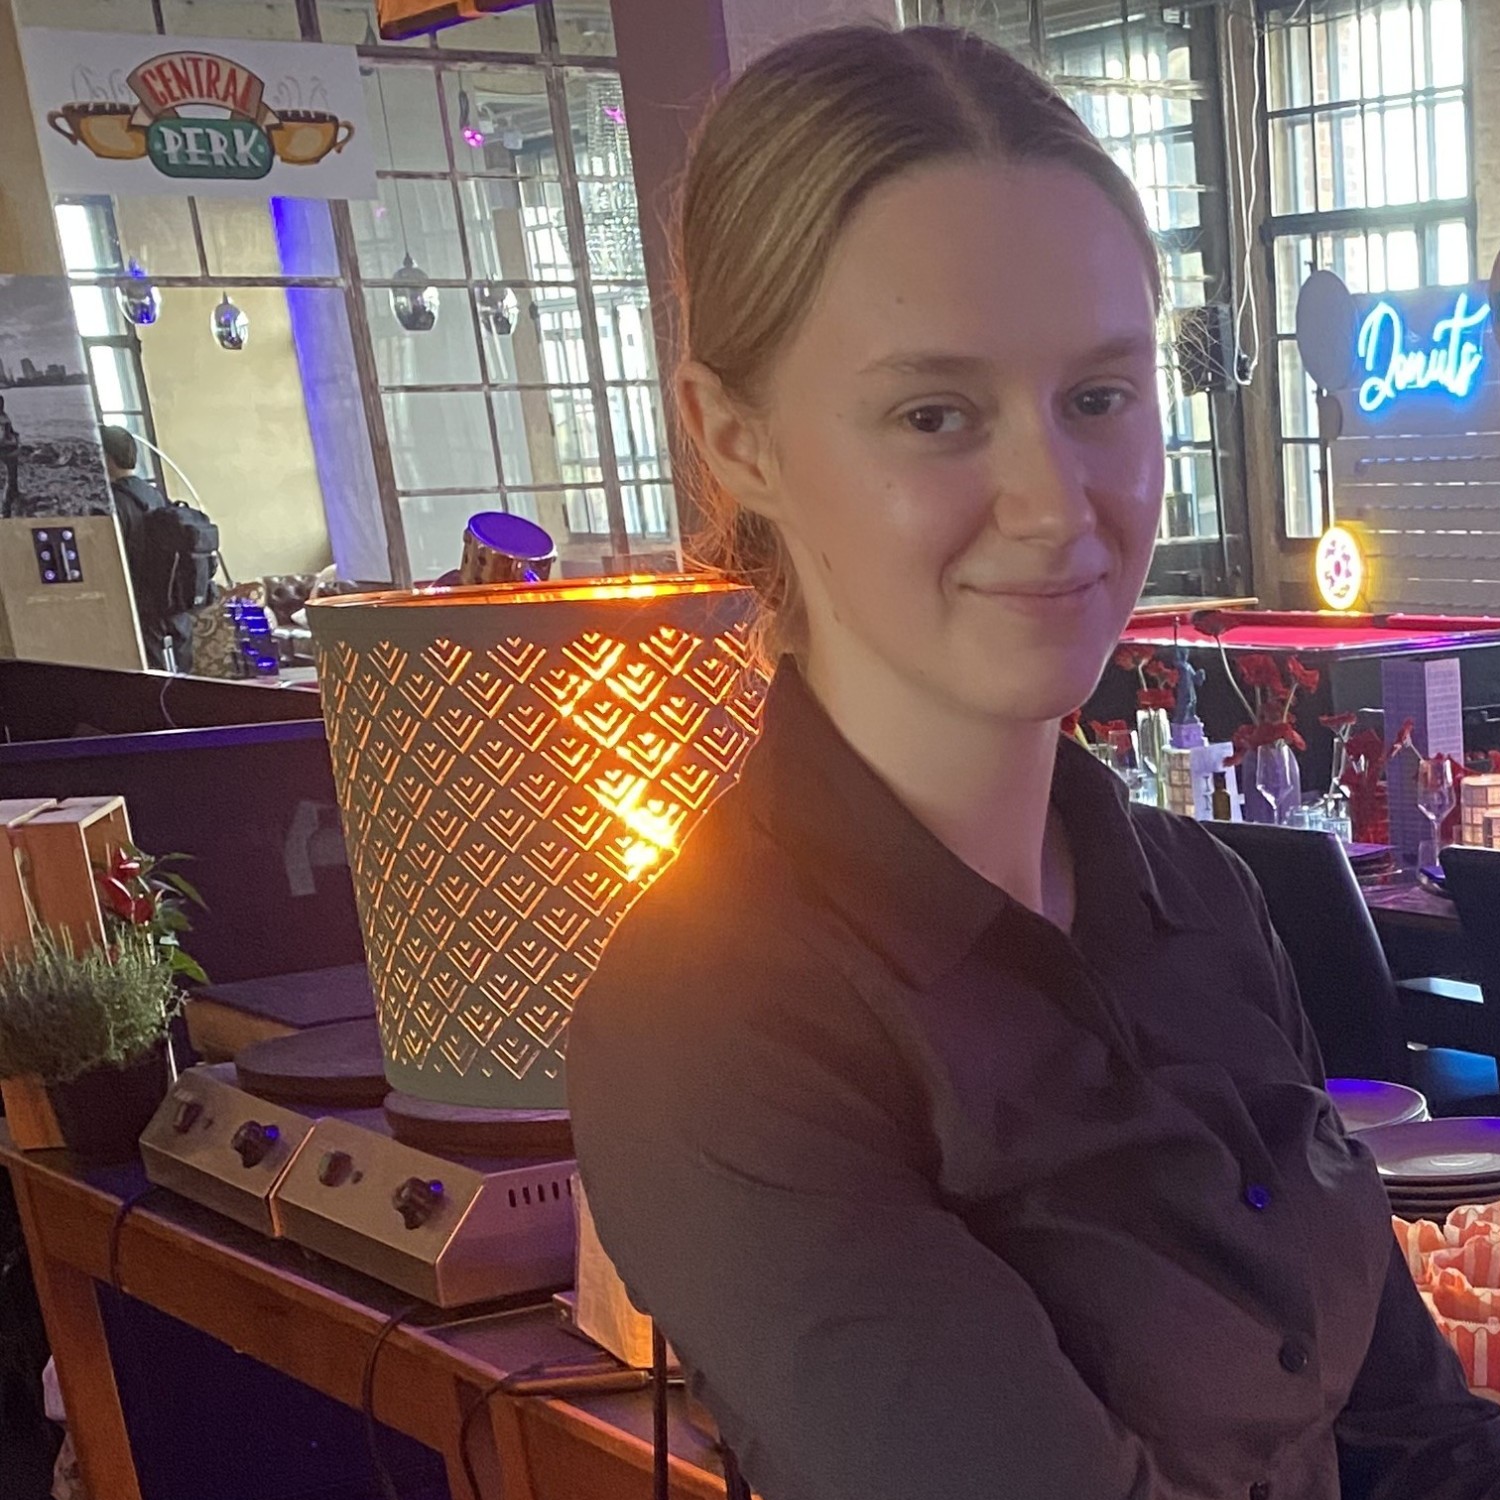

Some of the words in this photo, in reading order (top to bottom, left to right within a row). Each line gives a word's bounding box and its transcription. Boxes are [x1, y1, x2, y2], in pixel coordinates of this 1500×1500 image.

[140, 57, 255, 113] CENTRAL
[158, 126, 262, 168] PERK
[1357, 291, 1491, 412] Donuts
